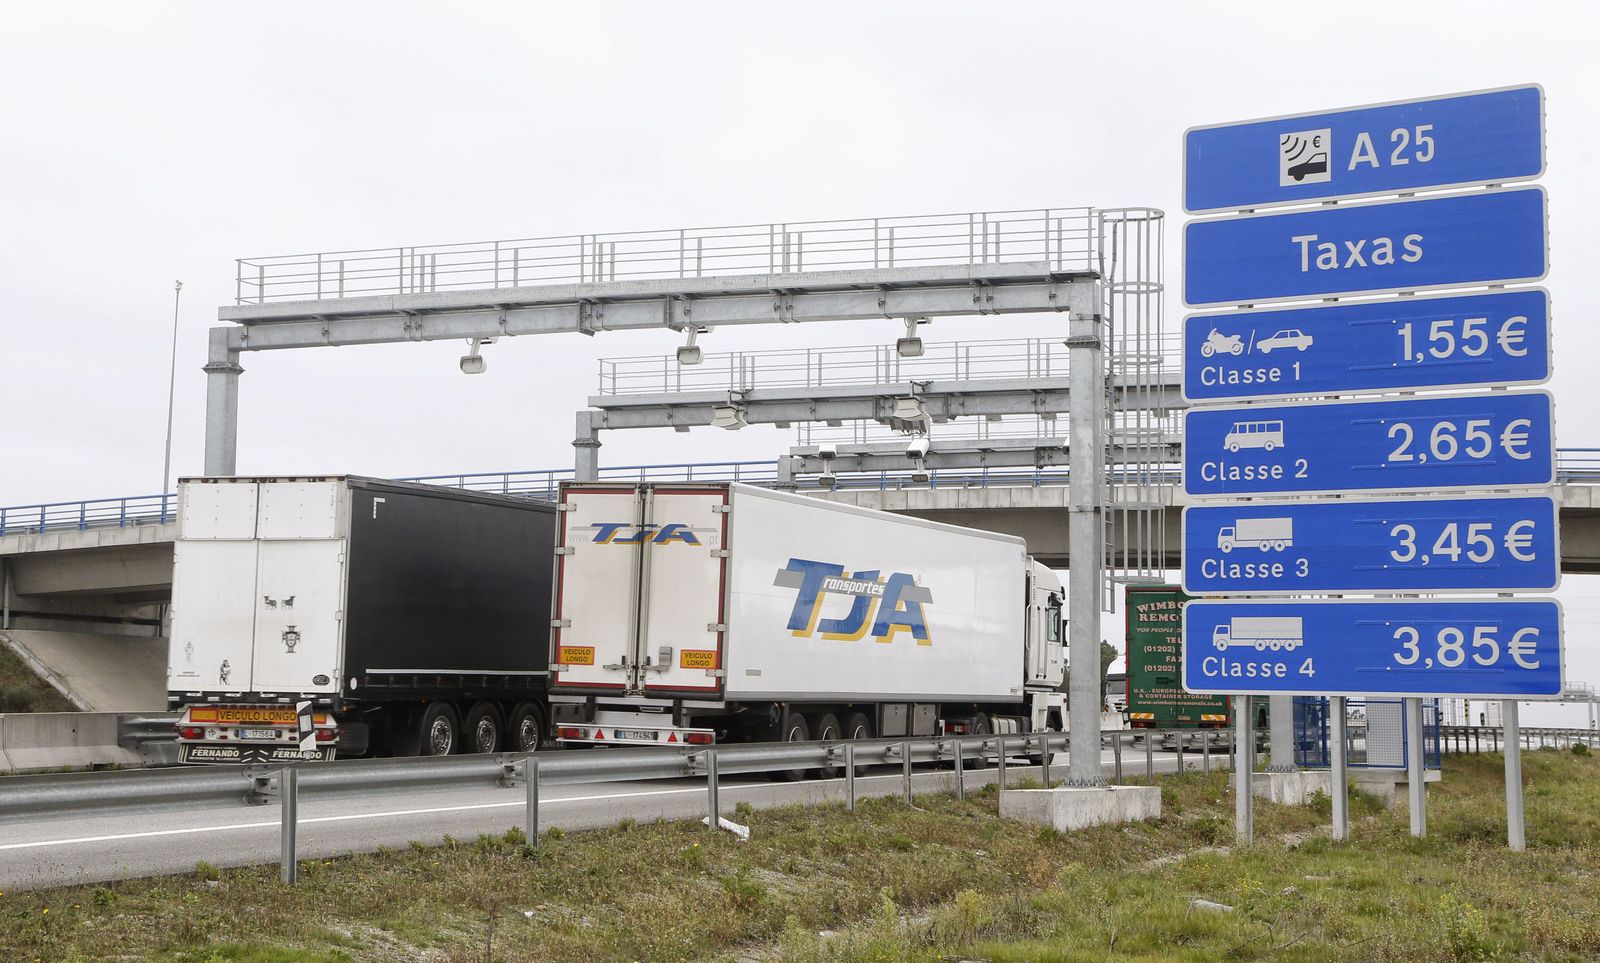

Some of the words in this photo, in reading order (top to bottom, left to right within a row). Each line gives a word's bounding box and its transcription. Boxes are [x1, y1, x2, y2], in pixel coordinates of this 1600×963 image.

[1348, 132, 1379, 170] A
[1390, 124, 1435, 167] 25
[1292, 232, 1424, 272] Taxas
[1201, 366, 1281, 386] Classe
[1292, 361, 1301, 381] 1
[1201, 462, 1283, 482] Classe
[1294, 458, 1309, 478] 2
[1201, 558, 1284, 579] Classe
[1295, 558, 1310, 578] 3
[823, 577, 885, 595] ransportes
[1139, 613, 1184, 621] REMO
[687, 659, 710, 667] LONGO
[1202, 657, 1287, 678] Classe
[1298, 657, 1315, 678] 4
[219, 711, 260, 721] VEICULO
[263, 712, 296, 721] LONGO
[191, 749, 240, 758] FERNANDO
[272, 750, 322, 759] FERNADO
